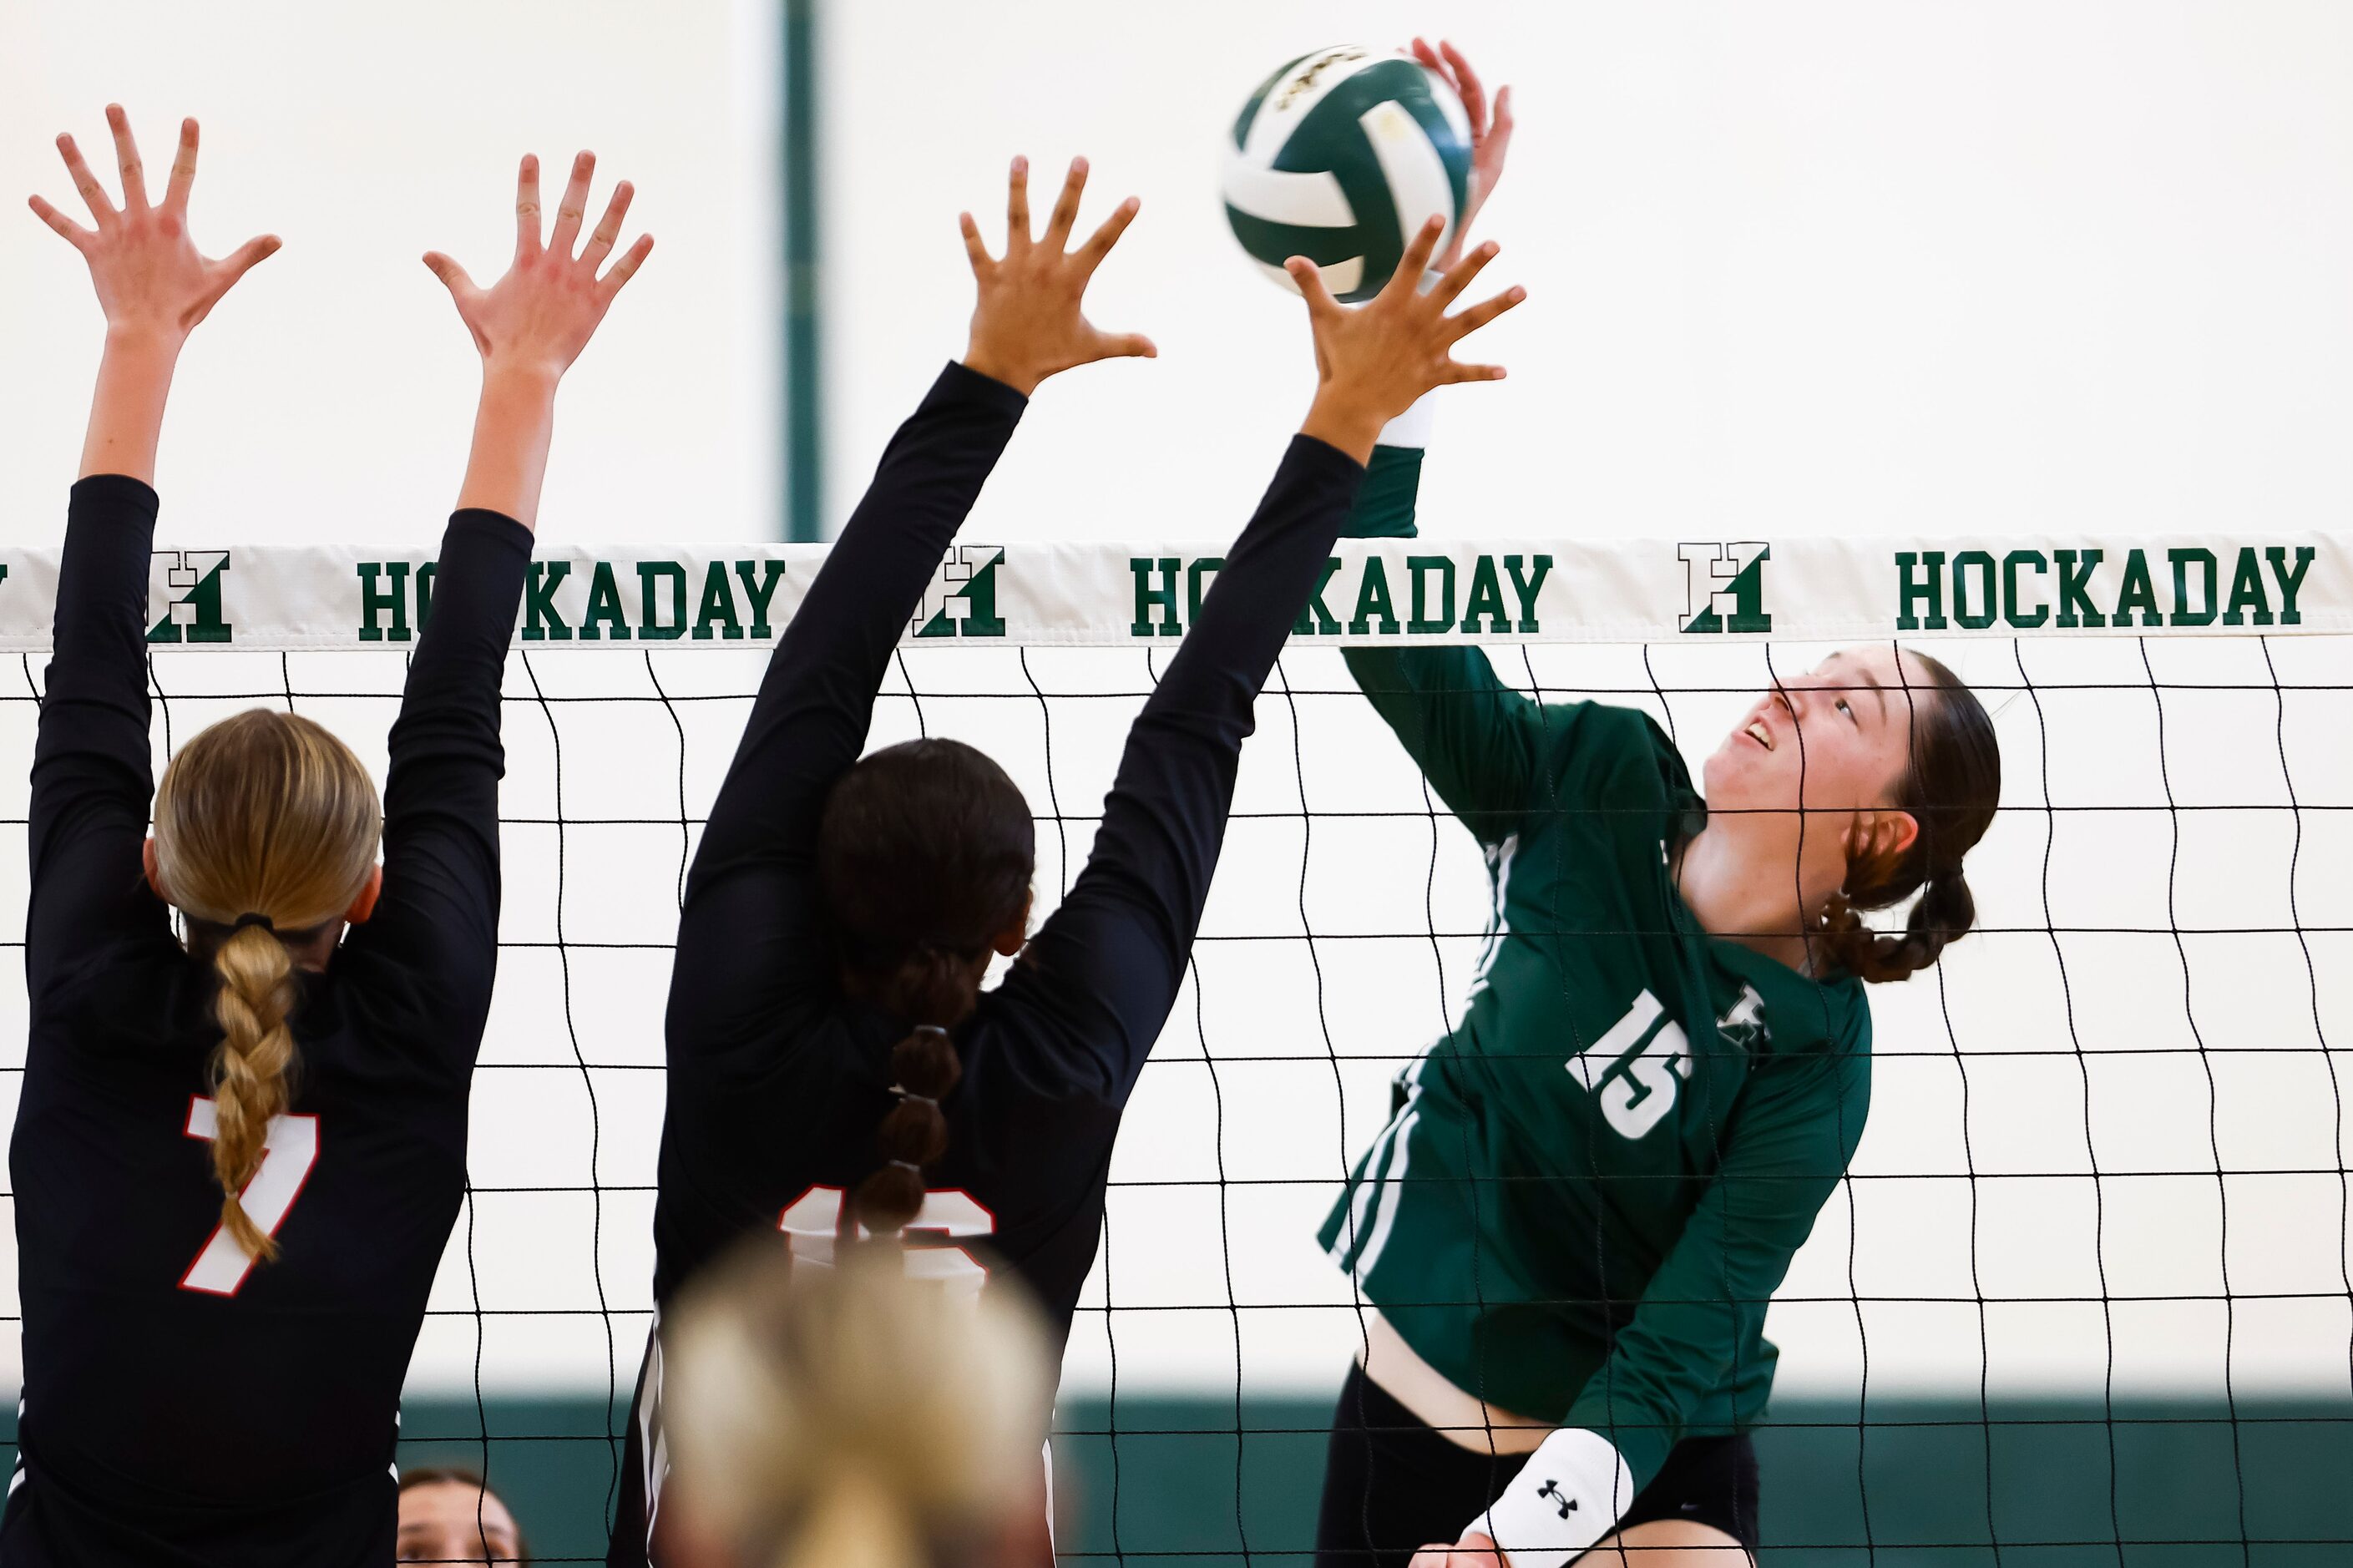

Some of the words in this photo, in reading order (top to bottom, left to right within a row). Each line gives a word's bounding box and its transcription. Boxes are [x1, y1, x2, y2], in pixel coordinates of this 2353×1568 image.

[357, 560, 787, 642] HKADAY
[1130, 554, 1554, 637] HKADAY
[1895, 546, 2316, 631] HOCKADAY
[1564, 988, 1693, 1141] 15
[176, 1093, 321, 1298] 7
